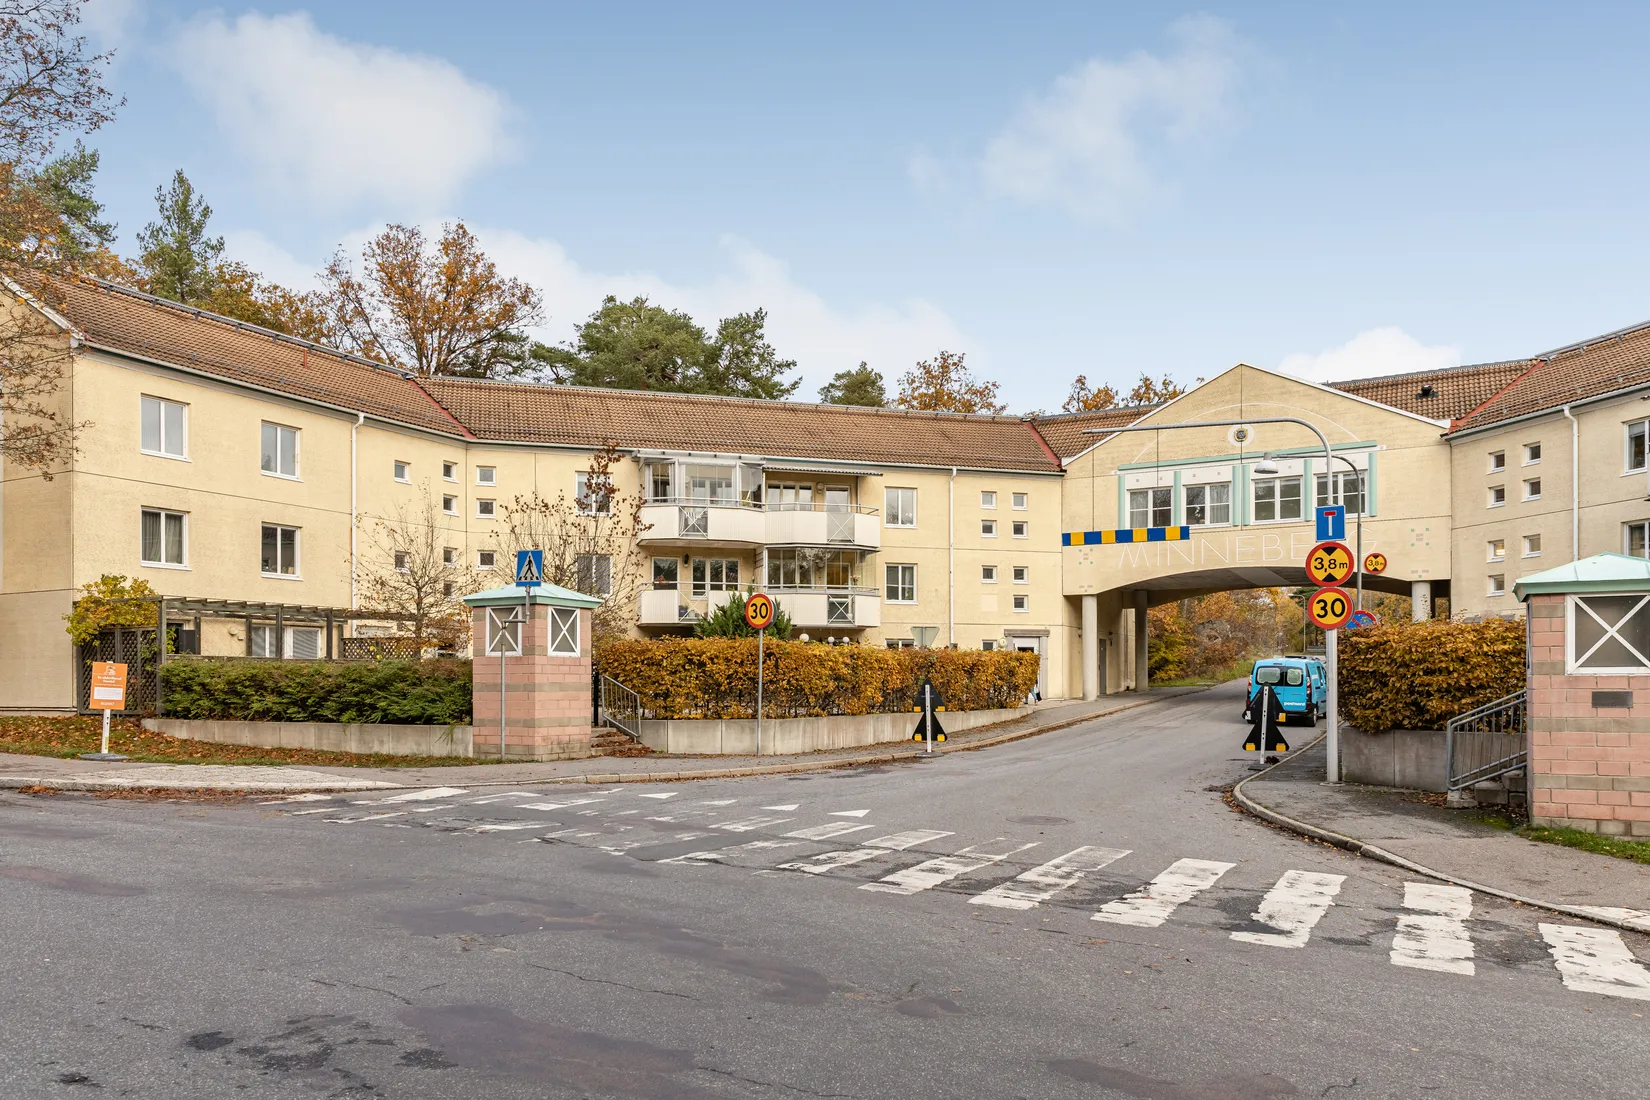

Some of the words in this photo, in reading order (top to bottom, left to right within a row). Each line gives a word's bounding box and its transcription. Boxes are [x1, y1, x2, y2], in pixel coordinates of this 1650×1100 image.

[1118, 528, 1377, 568] MINNEBEG
[750, 602, 768, 619] 30
[1316, 598, 1345, 618] 30
